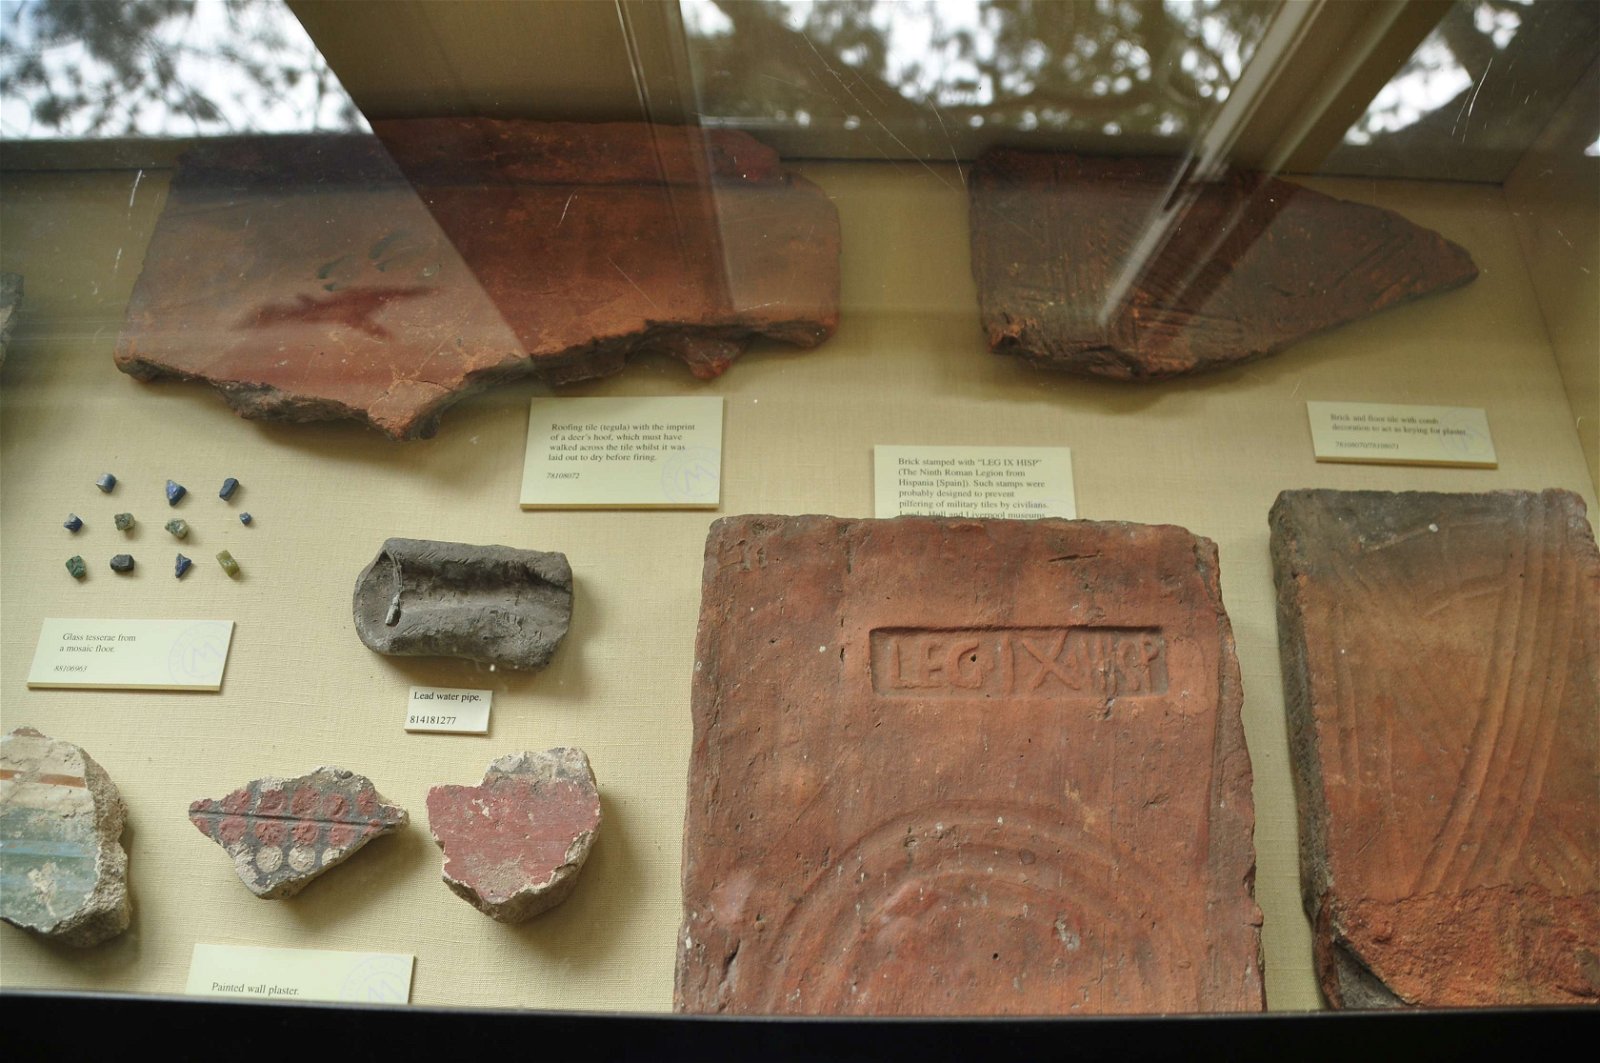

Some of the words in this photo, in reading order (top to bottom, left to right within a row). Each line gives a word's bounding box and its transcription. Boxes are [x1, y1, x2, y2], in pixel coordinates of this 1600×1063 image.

[551, 424, 583, 432] Roofing
[600, 424, 630, 432] (tegula)
[666, 424, 695, 432] imprint
[593, 434, 614, 442] hoof,
[590, 454, 603, 462] dry
[633, 454, 657, 462] firing.
[898, 457, 920, 465] Brick
[922, 458, 955, 466] stamped
[957, 458, 975, 466] with
[978, 458, 1001, 466] "LEG
[898, 468, 918, 476] (The
[920, 468, 943, 476] Ninth
[945, 468, 973, 476] Roman
[975, 469, 1002, 477] Legion
[1005, 469, 1026, 477] from
[899, 479, 934, 487] Hispania
[973, 479, 994, 487] Such
[995, 480, 1024, 488] stamps
[899, 489, 933, 498] probably
[936, 489, 972, 498] designed
[985, 490, 1015, 498] prevent
[899, 500, 933, 509] pilfering
[935, 500, 945, 508] of
[947, 500, 978, 509] military
[981, 500, 998, 508] tiles
[1000, 501, 1010, 510] by
[1012, 501, 1048, 509] civilians.
[62, 632, 84, 641] Glass
[117, 633, 136, 641] from
[413, 691, 435, 700] Lead
[436, 692, 460, 701] water
[460, 692, 482, 703] pipe.
[409, 715, 457, 725] 814181277
[211, 981, 245, 993] Painted
[247, 984, 266, 994] wall
[268, 985, 300, 996] plaster.
